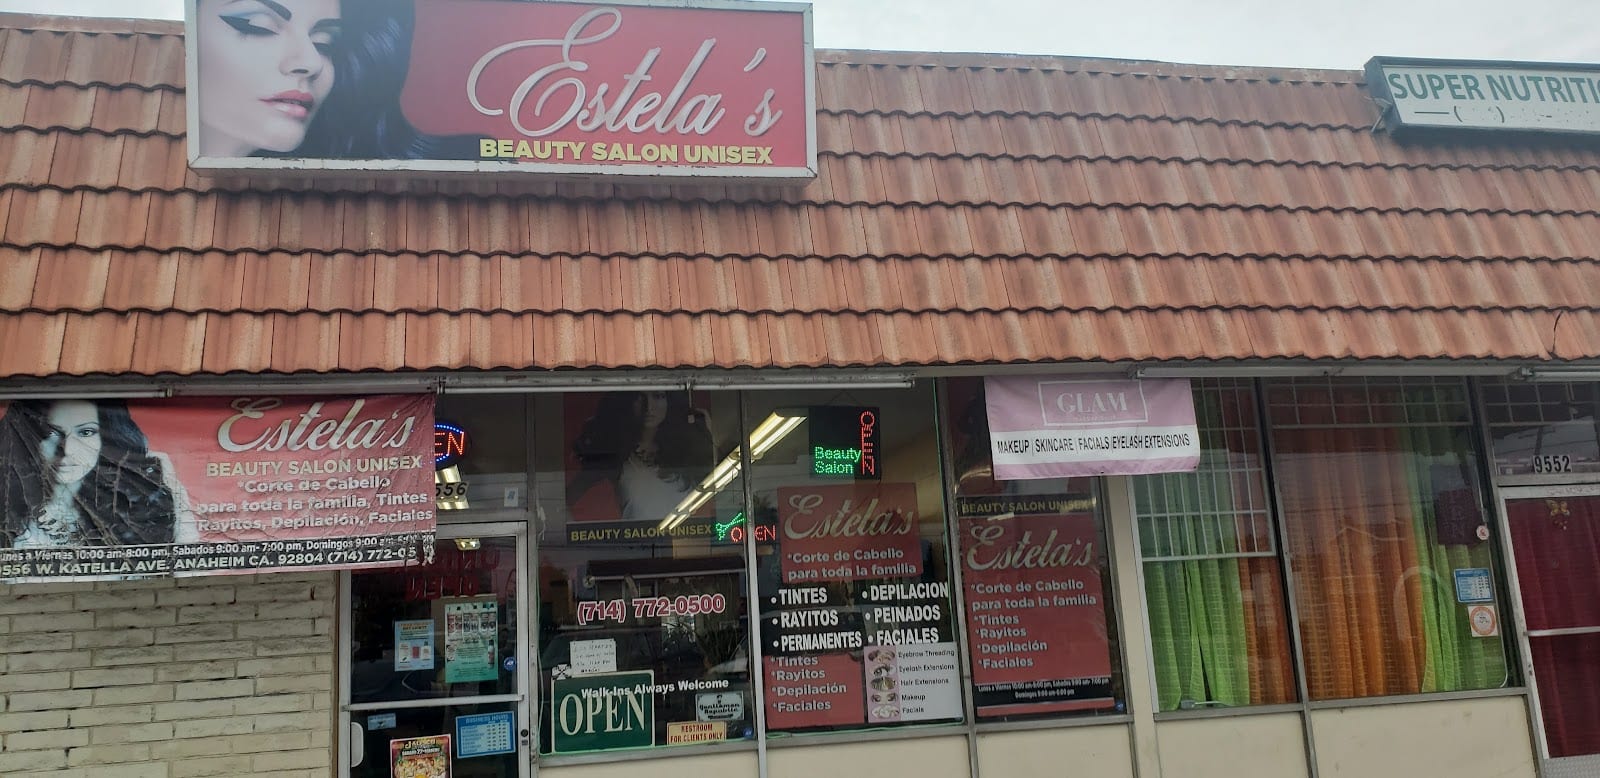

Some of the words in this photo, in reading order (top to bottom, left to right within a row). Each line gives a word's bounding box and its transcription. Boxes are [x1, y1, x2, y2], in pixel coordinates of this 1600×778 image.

[466, 7, 783, 137] Estela's
[1388, 73, 1485, 100] SUPER
[1486, 74, 1600, 104] NUTRITI
[479, 139, 586, 161] BEAUTY
[591, 142, 679, 163] SALON
[684, 144, 773, 165] UNISEX
[1056, 391, 1128, 414] GLAM
[217, 397, 416, 453] Estela's
[997, 439, 1030, 454] MAKEUP
[1034, 438, 1074, 453] SKINCARE
[1078, 436, 1110, 451] FACIALS
[1112, 435, 1143, 450] EYELASH
[1144, 433, 1190, 449] EXTENSIONS
[814, 446, 862, 463] Beauty
[1534, 455, 1571, 473] 9552
[206, 461, 284, 478] BEAUTY
[287, 458, 351, 476] SALON
[356, 455, 422, 473] UNISEX
[814, 460, 854, 474] Salon
[298, 478, 321, 491] de
[325, 475, 391, 490] Cabello
[196, 501, 237, 515] para
[242, 498, 283, 511] toda
[287, 496, 303, 510] la
[307, 494, 371, 511] familia,
[376, 492, 428, 506] Tintes
[962, 502, 1005, 514] BEAUTY
[1008, 501, 1046, 512] SALON
[1048, 499, 1089, 511] UNISEX
[198, 519, 267, 534] Rayitos,
[271, 514, 364, 530] Depilación,
[368, 510, 433, 524] Faciales
[784, 494, 914, 540] Estela's
[570, 528, 621, 542] BEAUTY
[624, 526, 666, 540] SALON
[668, 524, 712, 537] UNISEX
[25, 552, 32, 560] a
[34, 550, 73, 560] Viernes
[76, 549, 105, 560] 10:00
[151, 548, 170, 558] pm,
[172, 545, 214, 556] Sabados
[216, 544, 239, 554] 9:00
[262, 542, 284, 552] 7:00
[286, 542, 304, 552] pm,
[306, 540, 354, 551] Domingos
[355, 537, 377, 548] 9:00
[833, 550, 850, 561] de
[853, 548, 904, 560] Cabello
[966, 525, 1093, 571] Estela's
[0, 563, 31, 576] 556
[35, 563, 55, 575] W.
[58, 561, 131, 574] KATELLA
[135, 560, 170, 572] AVE.
[173, 556, 245, 569] ANAHEIM
[248, 554, 274, 567] CA.
[278, 552, 323, 566] 92804
[327, 550, 364, 564] (714)
[788, 568, 818, 581] para
[821, 566, 853, 578] toda
[856, 564, 868, 576] la
[871, 563, 917, 575] familia
[778, 587, 828, 605] TINTES
[870, 582, 949, 601] DEPILACION
[1015, 581, 1032, 593] de
[1035, 579, 1084, 592] Cabello
[577, 599, 626, 625] (714)
[632, 593, 726, 618] 772-0500
[972, 599, 1002, 612] para
[1005, 597, 1035, 609] toda
[1038, 596, 1050, 607] la
[1053, 594, 1097, 606] familia
[781, 609, 839, 628] RAYITOS
[874, 604, 941, 623] PEINADOS
[781, 631, 862, 652] PERMANENTES
[876, 627, 939, 646] FACIALES
[898, 651, 924, 660] Eyebrow
[925, 649, 955, 659] Threading
[899, 664, 922, 673] Eyelash
[923, 663, 955, 673] Extensions
[581, 686, 631, 700] Walk-Ins
[634, 682, 675, 696] Always
[677, 678, 729, 692] Welcome
[900, 679, 913, 687] Hair
[914, 678, 950, 686] Extensions
[901, 693, 926, 703] Makeup
[559, 691, 645, 736] OPEN
[902, 706, 925, 715] Facials
[671, 735, 682, 744] FOR
[708, 731, 723, 741] ONLY
[681, 723, 713, 733] RESTROOM
